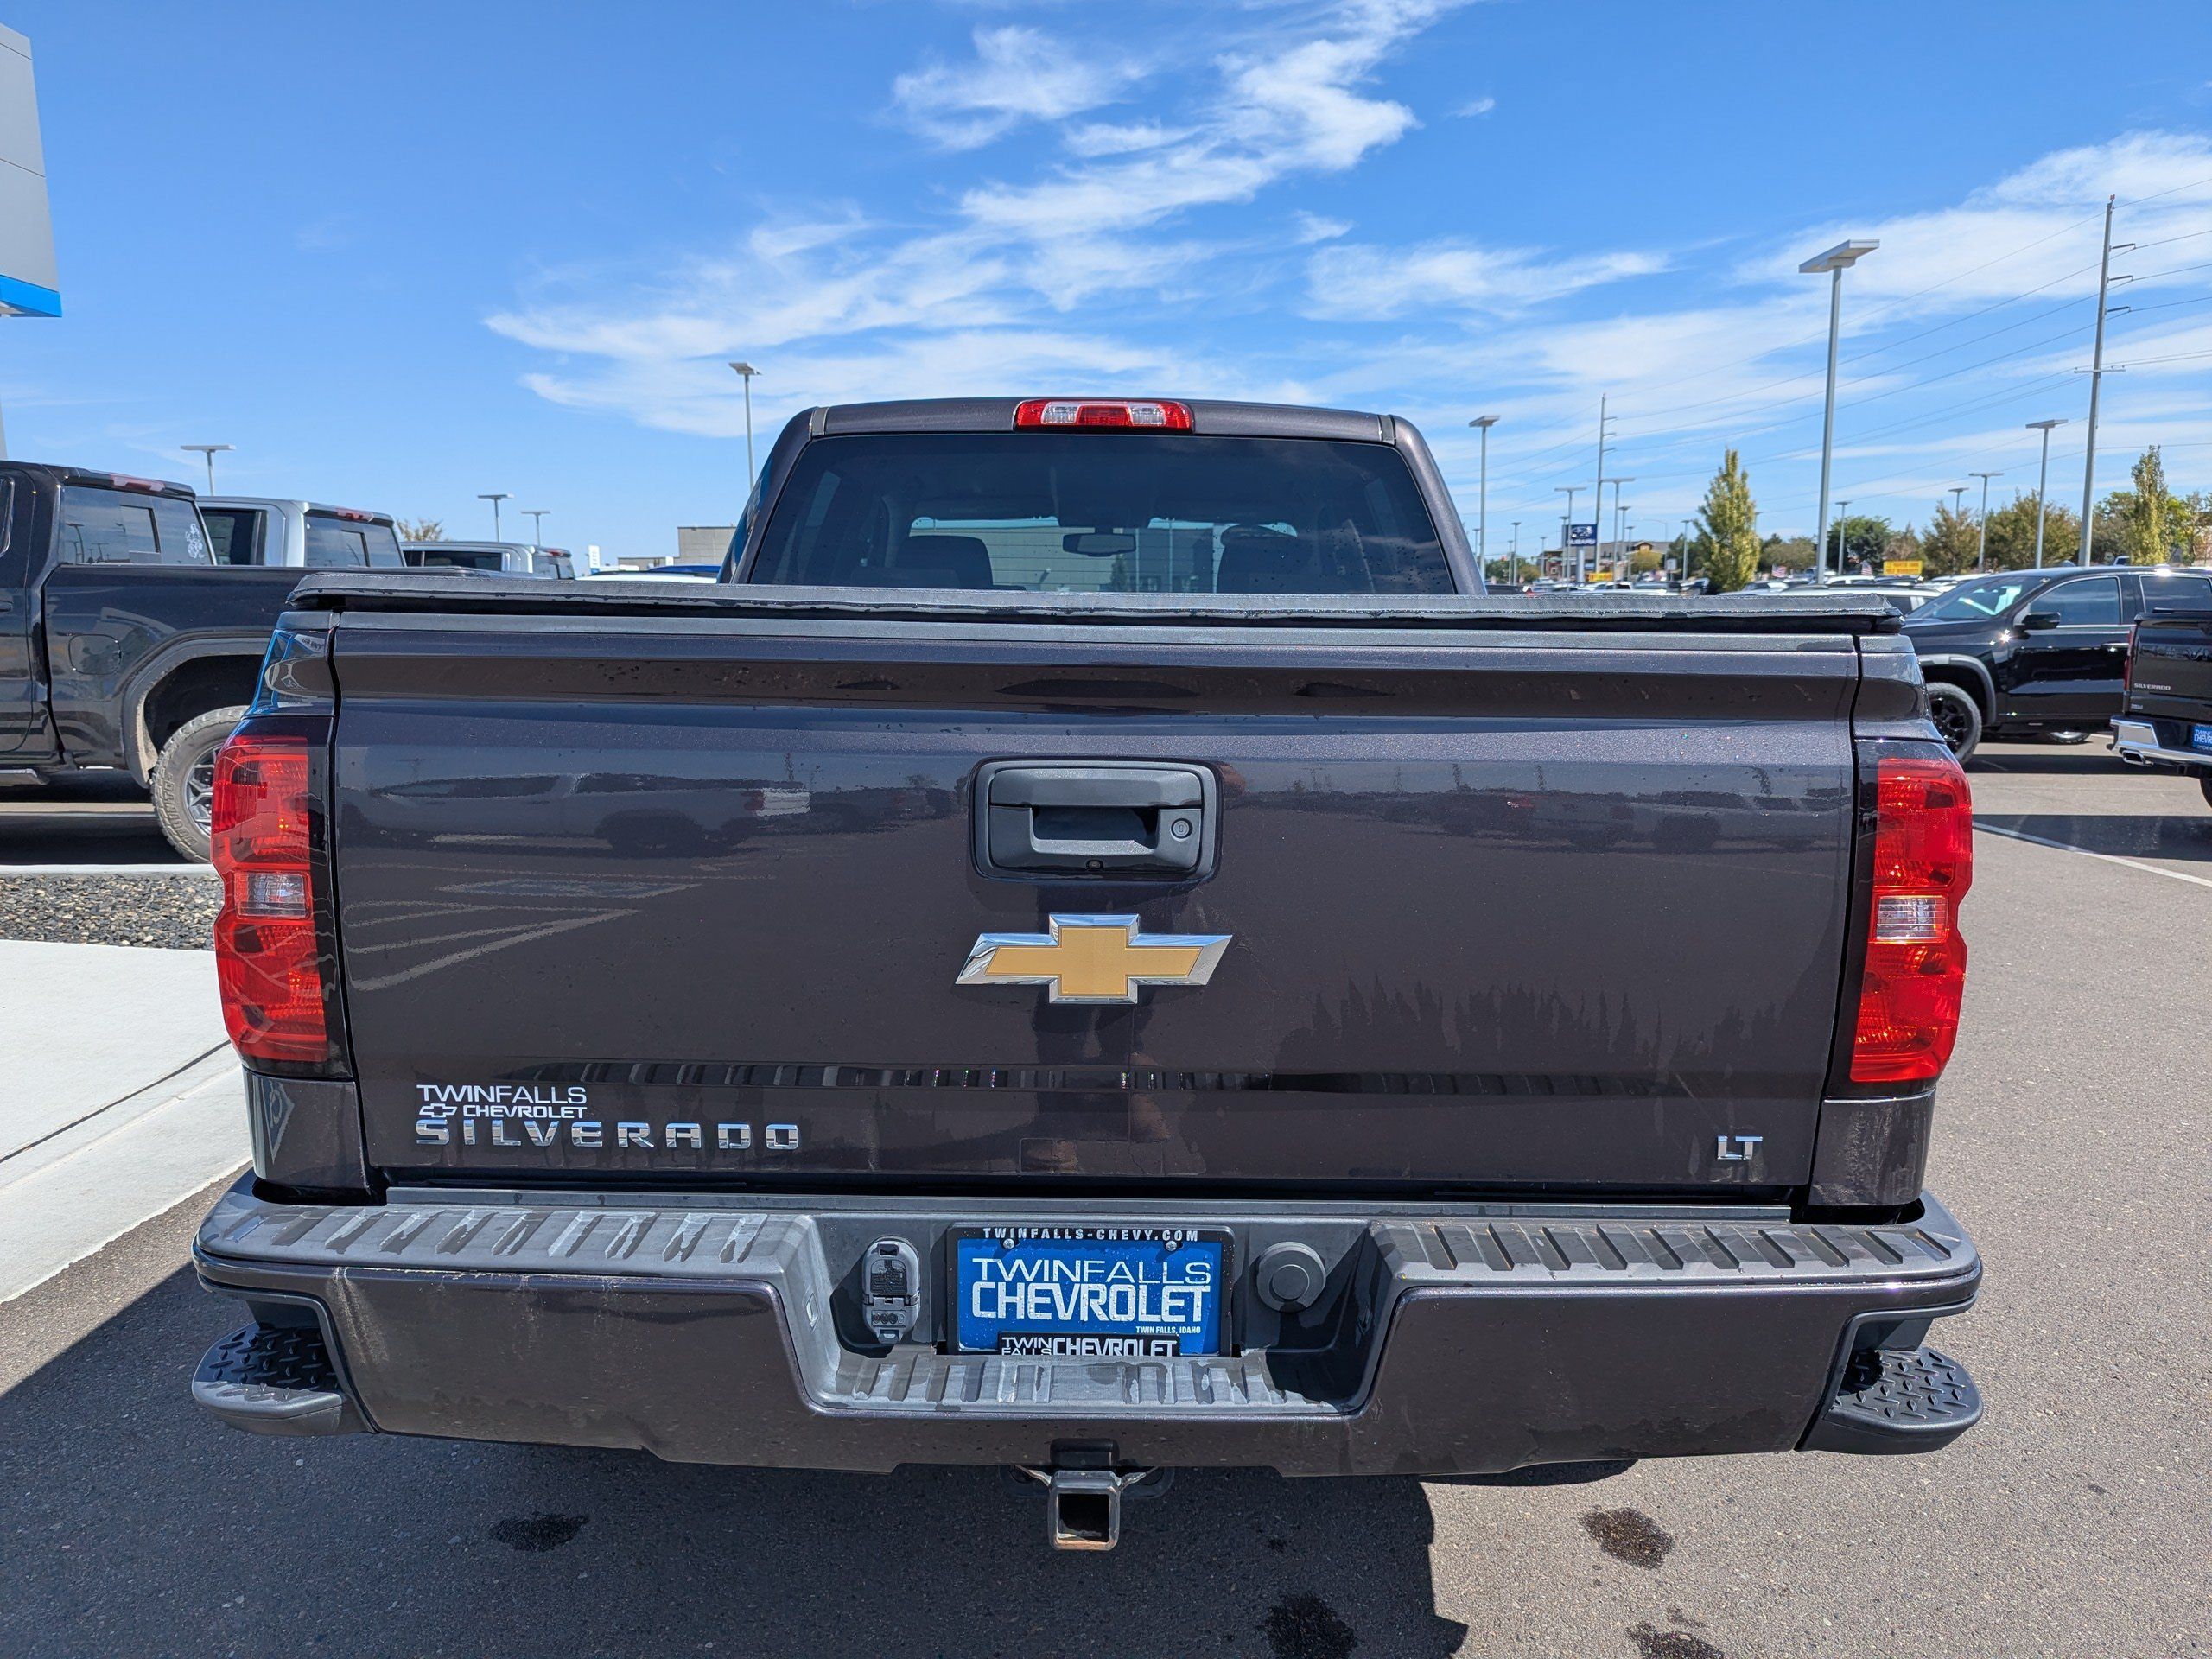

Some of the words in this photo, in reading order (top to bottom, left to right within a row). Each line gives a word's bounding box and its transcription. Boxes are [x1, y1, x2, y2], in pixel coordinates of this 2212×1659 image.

[416, 1084, 587, 1105] TWINFALLS
[462, 1104, 587, 1119] CHEVROLET
[416, 1118, 799, 1150] SILVERADO
[1717, 1135, 1764, 1160] LT
[982, 1227, 1199, 1243] TWINFALLS-CHEVY.COM
[972, 1258, 1211, 1285] TWINFALLS
[972, 1282, 1211, 1323] CHEVROLET
[1136, 1325, 1155, 1334] TWIN
[1155, 1325, 1179, 1336] FALLS,
[1179, 1325, 1201, 1334] IDAHO
[1001, 1337, 1052, 1349] TWIN
[1052, 1337, 1178, 1357] CHEVROLET
